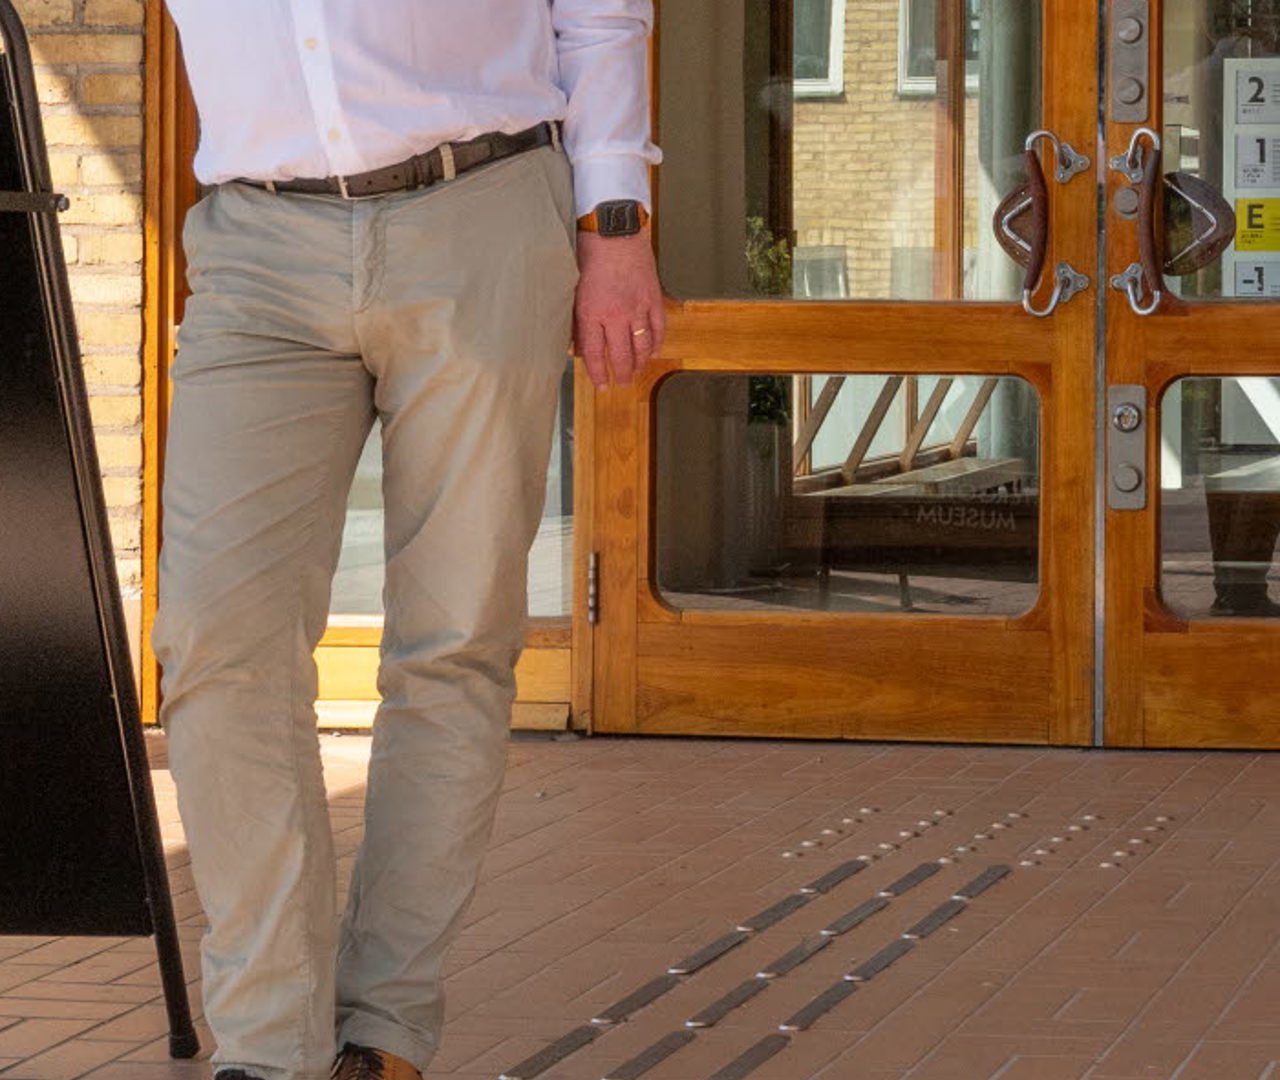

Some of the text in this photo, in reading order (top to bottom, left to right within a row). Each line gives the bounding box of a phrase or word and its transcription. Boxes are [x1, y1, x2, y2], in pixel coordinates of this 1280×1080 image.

[1247, 76, 1266, 104] 2
[1255, 138, 1266, 164] 1
[1247, 204, 1265, 229] E
